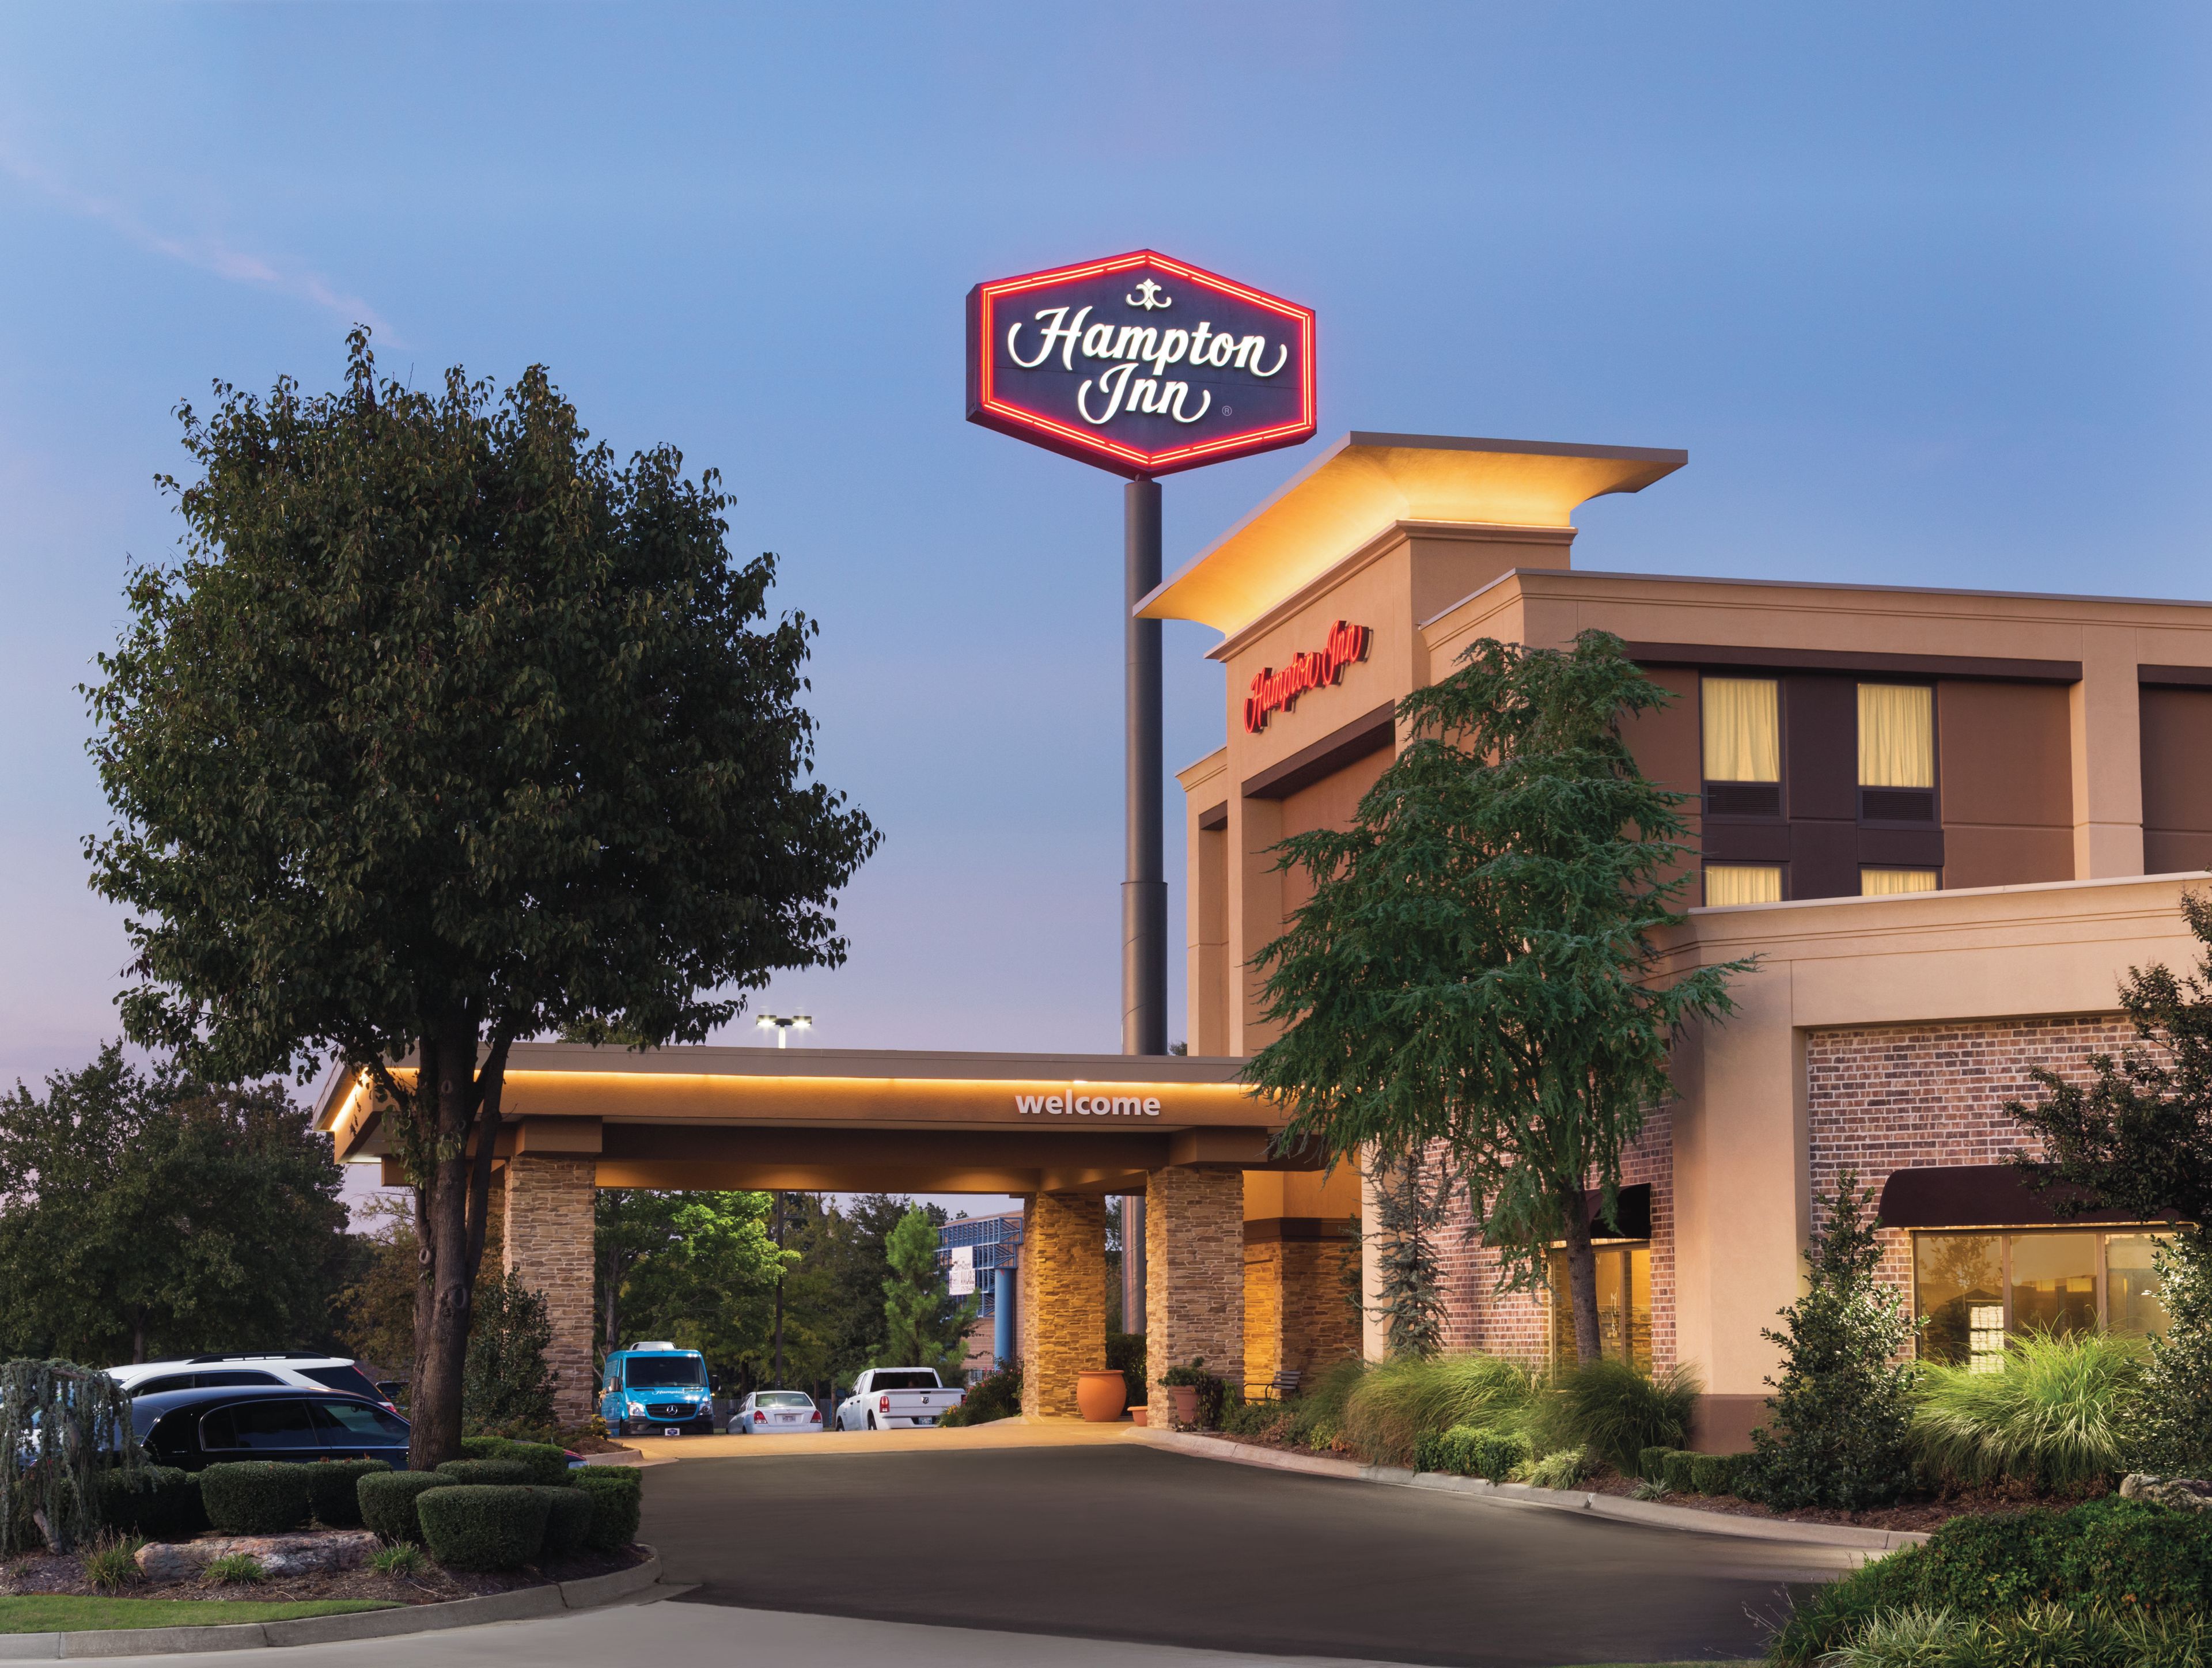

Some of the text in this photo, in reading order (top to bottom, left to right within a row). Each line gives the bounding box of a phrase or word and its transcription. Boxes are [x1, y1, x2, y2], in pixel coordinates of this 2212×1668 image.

[1007, 305, 1287, 377] Hampton
[1077, 362, 1211, 424] Inn
[1244, 620, 1363, 734] Hampton Inn
[1015, 1089, 1161, 1116] welcome
